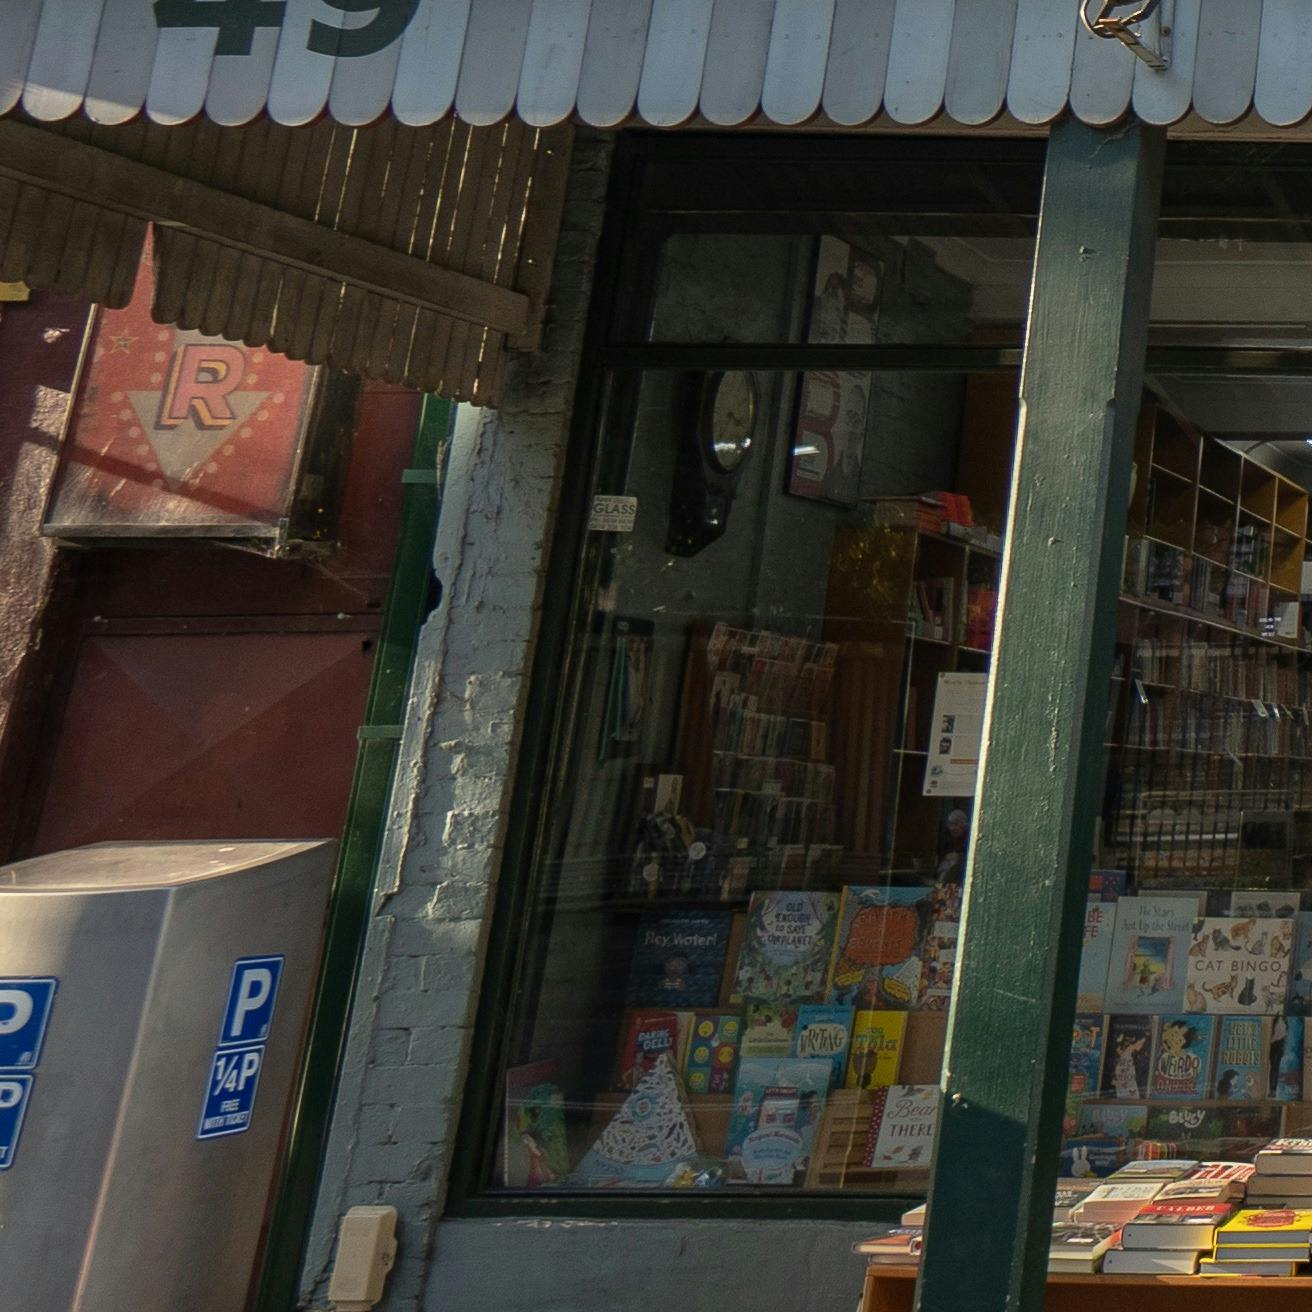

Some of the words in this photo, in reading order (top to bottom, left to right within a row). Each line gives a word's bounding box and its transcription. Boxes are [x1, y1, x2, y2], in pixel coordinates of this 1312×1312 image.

[155, 343, 247, 430] R
[592, 503, 636, 515] GLASS
[672, 932, 719, 947] Water!
[1195, 960, 1224, 972] CAT
[1231, 960, 1282, 972] BINGO
[231, 968, 273, 1037] P
[799, 1027, 844, 1054] WRITING
[1159, 1052, 1200, 1078] WEIRDO
